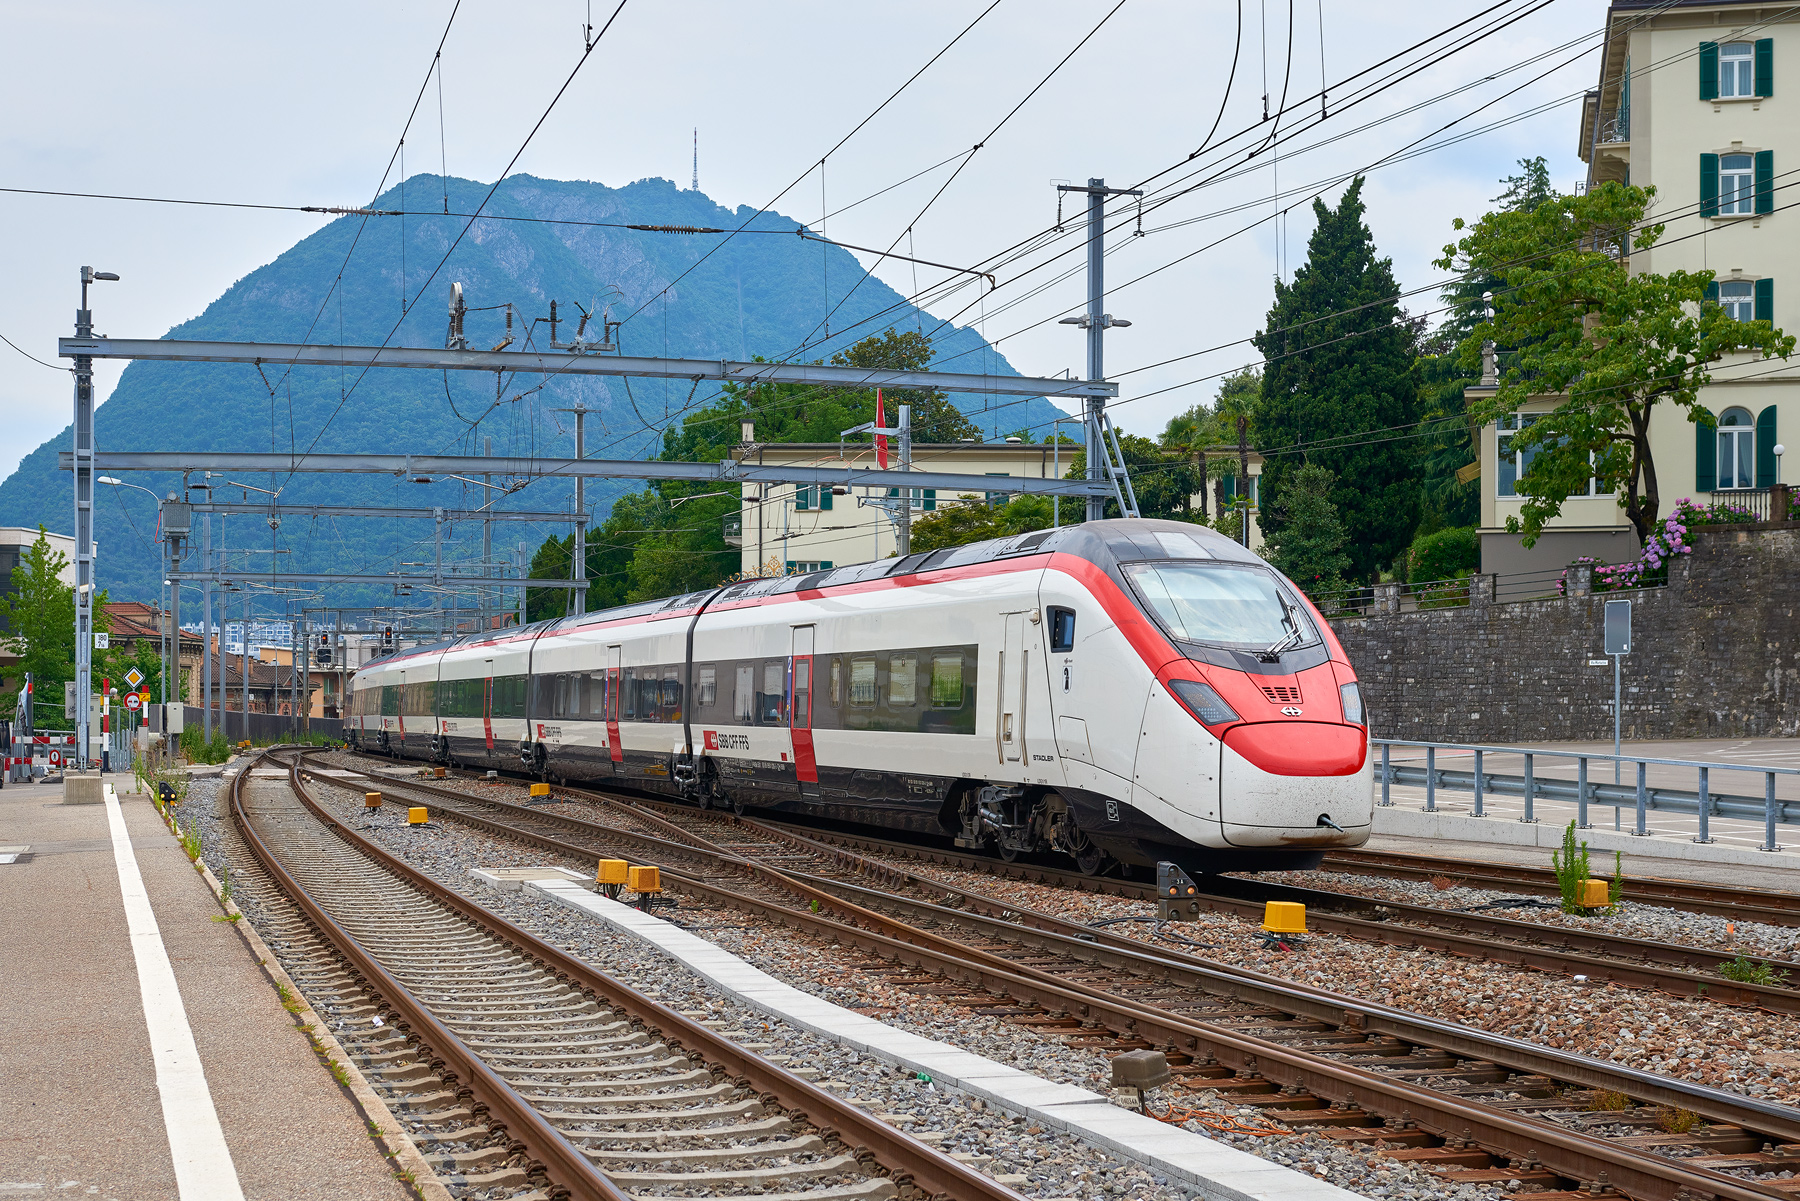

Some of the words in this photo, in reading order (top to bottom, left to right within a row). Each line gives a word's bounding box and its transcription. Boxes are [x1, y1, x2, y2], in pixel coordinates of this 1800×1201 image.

[719, 734, 729, 748] SBB
[729, 734, 739, 749] CFF
[739, 735, 749, 750] FFS
